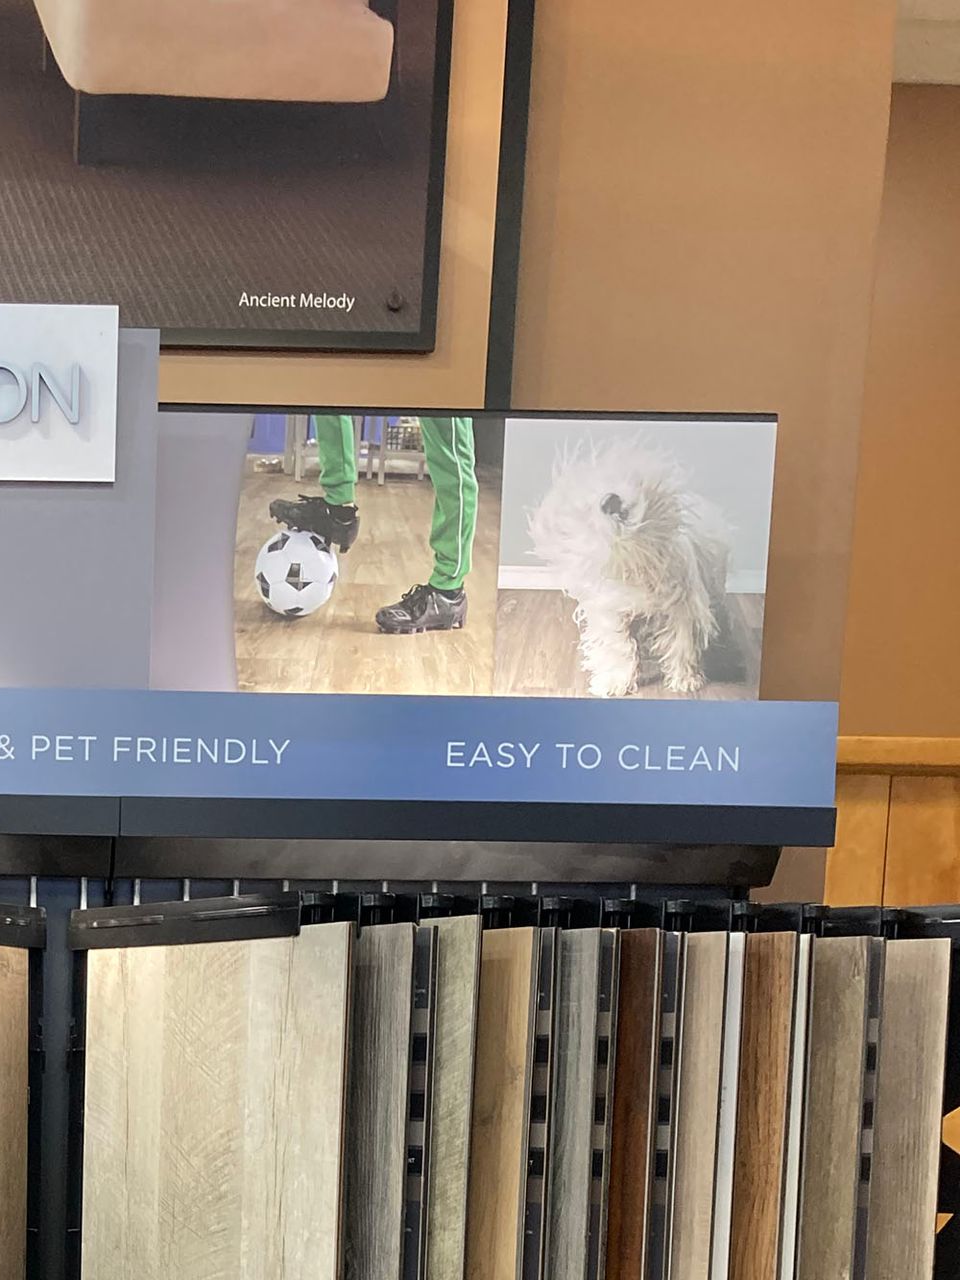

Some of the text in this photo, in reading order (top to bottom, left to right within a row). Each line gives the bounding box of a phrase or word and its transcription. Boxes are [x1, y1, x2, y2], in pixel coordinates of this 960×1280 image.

[239, 292, 355, 312] Ancient Melody
[32, 735, 97, 761] PET
[113, 737, 290, 765] FRIENDLY
[446, 742, 740, 772] EASY TO CLEAN
